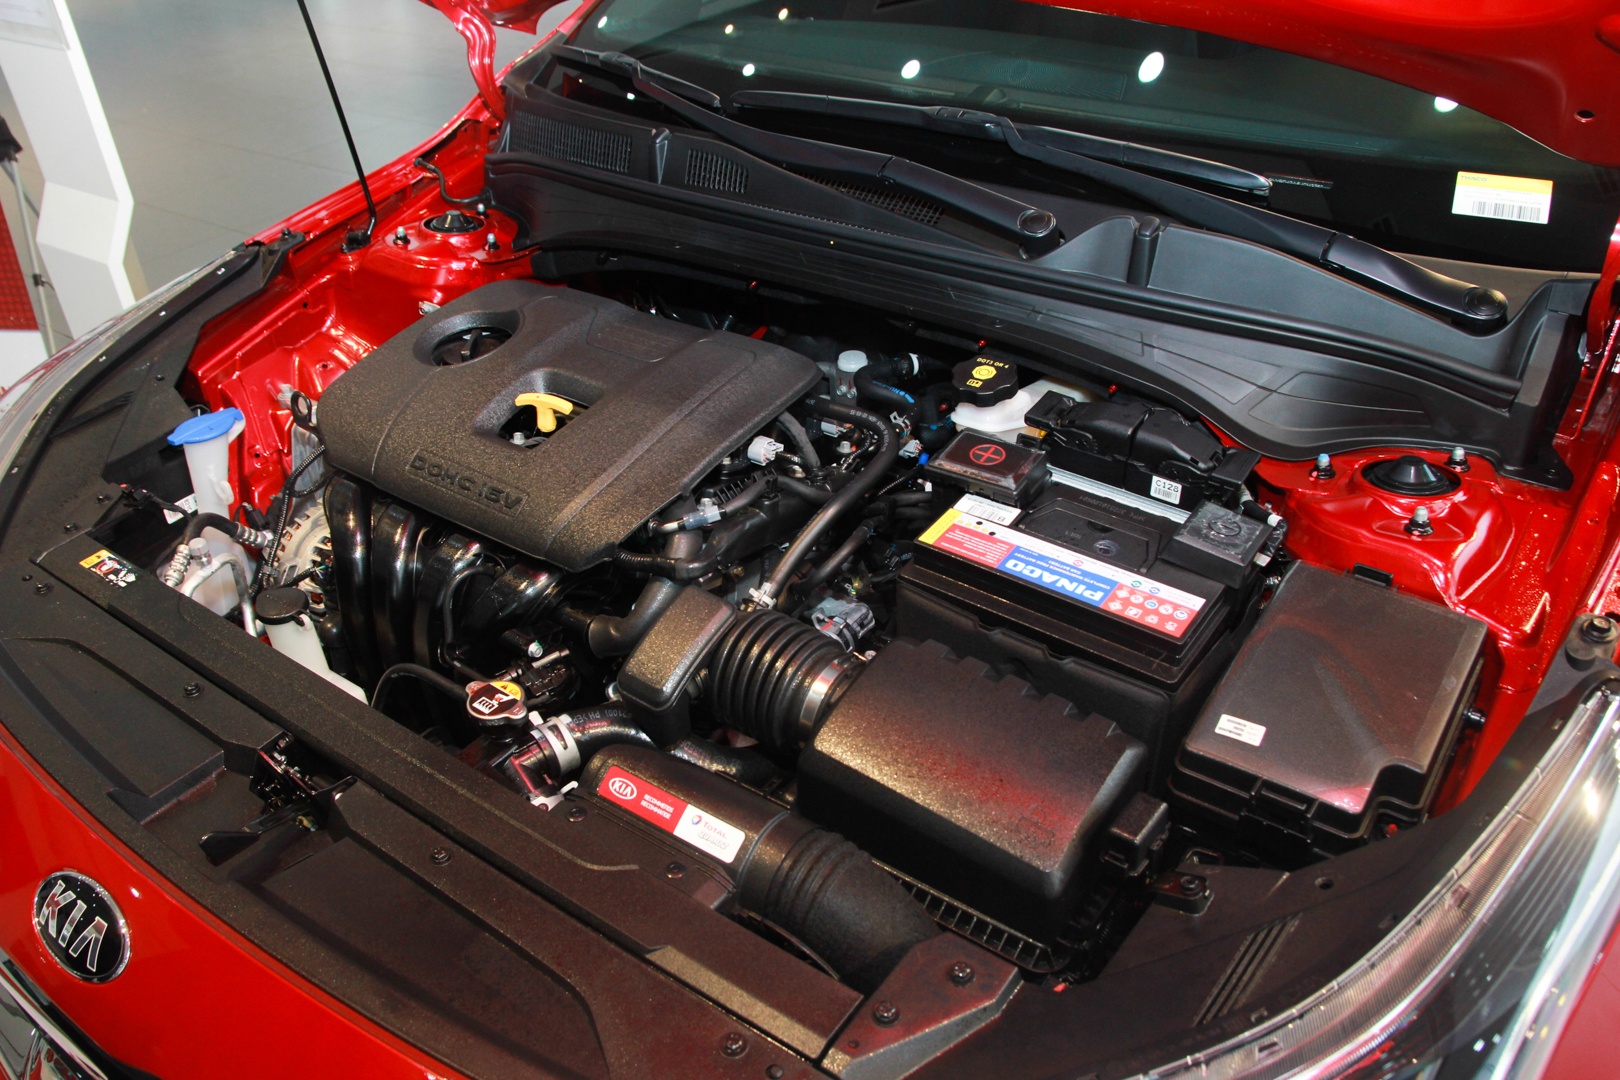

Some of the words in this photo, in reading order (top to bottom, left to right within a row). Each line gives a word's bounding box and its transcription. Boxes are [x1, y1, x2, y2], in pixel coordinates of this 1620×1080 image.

[976, 357, 994, 365] DOT3
[1155, 479, 1179, 493] C128
[1014, 552, 1037, 563] BATTERY
[1048, 560, 1071, 571] BATTERY
[1005, 559, 1104, 602] PINACO
[1083, 577, 1111, 590] COMPLETE
[612, 779, 632, 798] KIA
[640, 799, 672, 820] RECOMMANDE
[643, 793, 675, 813] RECOMMENDS
[703, 821, 727, 839] TOTAL
[39, 879, 108, 973] KIA
